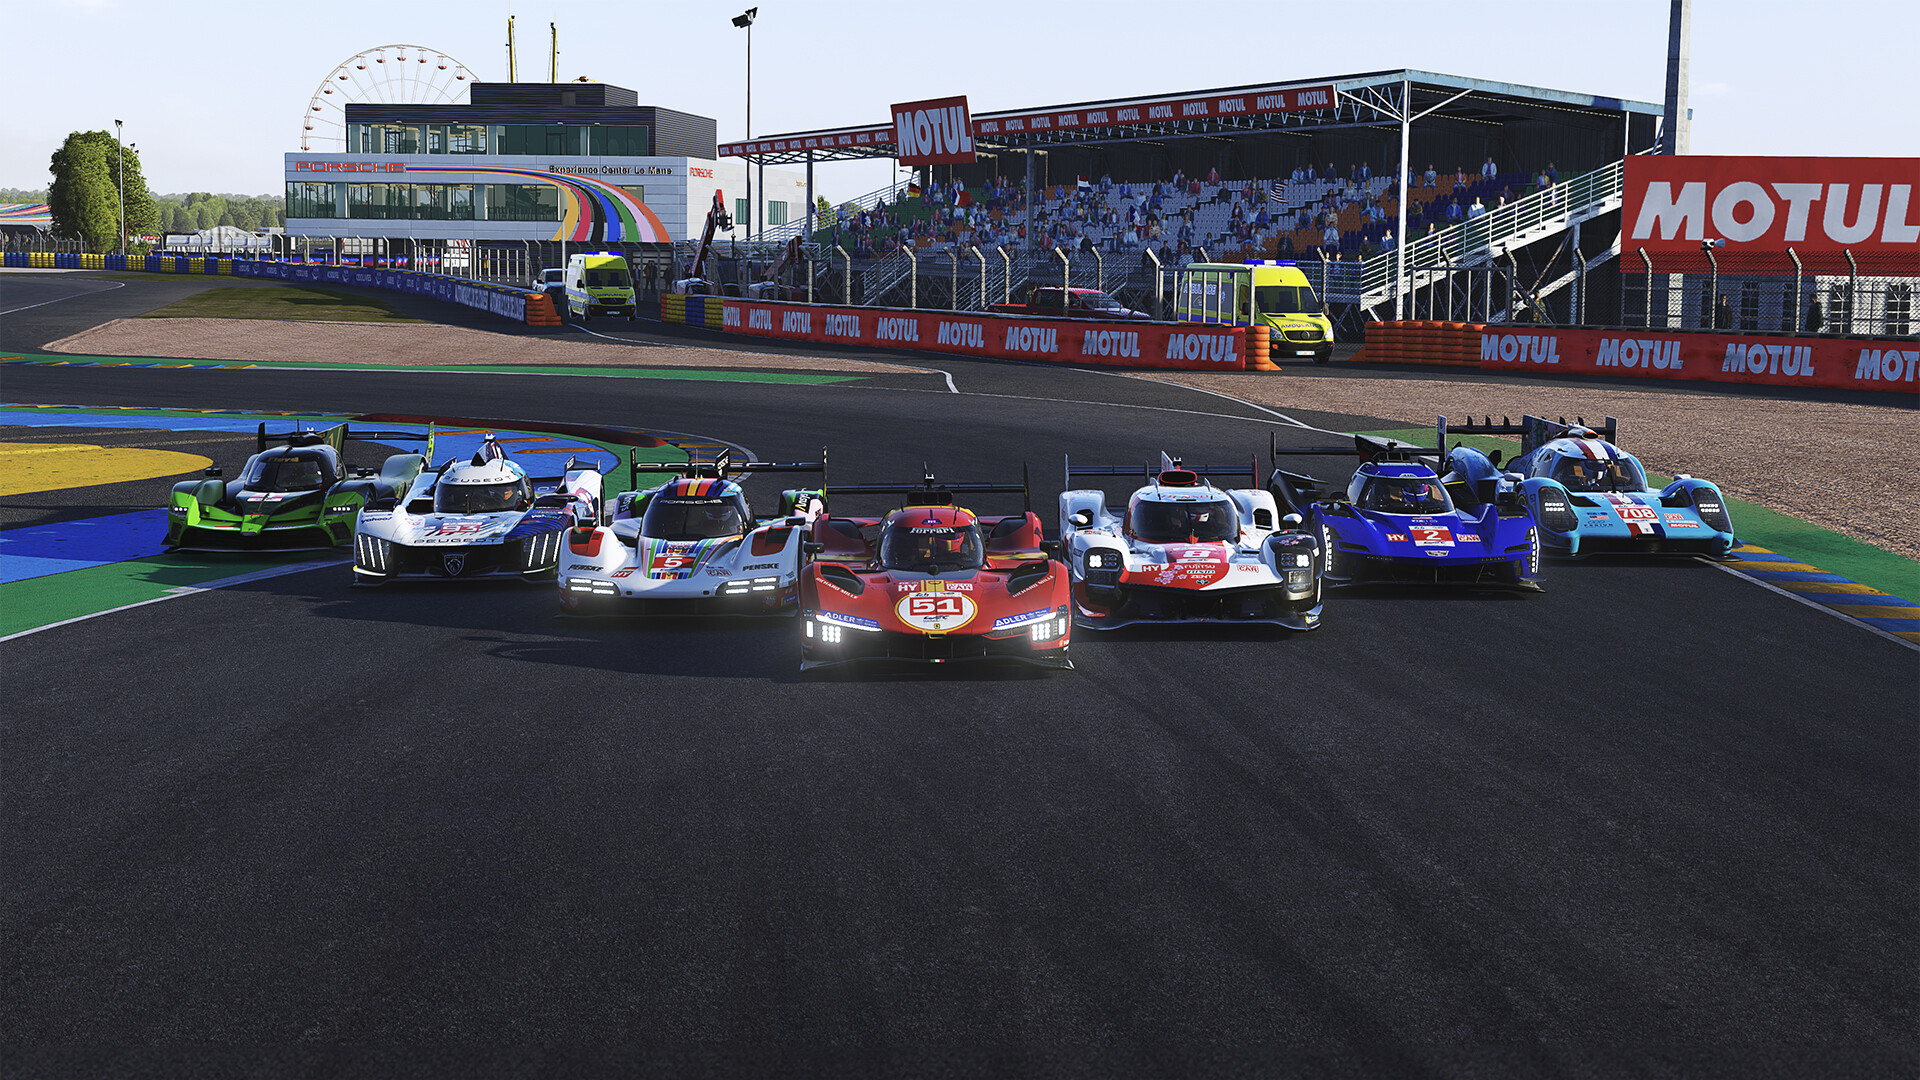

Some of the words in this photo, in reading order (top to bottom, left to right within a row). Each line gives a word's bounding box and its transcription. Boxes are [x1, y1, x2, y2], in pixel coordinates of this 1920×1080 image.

[981, 122, 999, 133] MOTUL
[1005, 119, 1024, 131] MOTUL
[1031, 117, 1050, 129] MOTUL
[1058, 114, 1079, 126] MOTUL
[1087, 111, 1109, 124] MOTUL
[1117, 108, 1140, 122] MOTUL
[1149, 105, 1173, 119] MOTUL
[1183, 102, 1209, 116] MOTUL
[1218, 98, 1246, 113] MOTUL
[1256, 94, 1286, 110] MOTUL
[1297, 90, 1328, 106] MOTUL
[896, 105, 972, 157] MOTUL
[296, 162, 405, 172] PORSCHE
[549, 165, 599, 175] Experience
[602, 165, 631, 174] Center
[635, 166, 646, 174] Le
[649, 166, 673, 175] Mans
[690, 167, 713, 179] PORSCHE
[1631, 181, 1920, 244] MOTUL
[749, 308, 772, 330] MOTUL
[782, 311, 812, 334] MOTUL
[825, 314, 861, 338] MOTUL
[876, 317, 919, 342] MOTUL
[937, 321, 985, 348] MOTUL
[1005, 326, 1059, 353] MOTUL
[1082, 330, 1141, 358] MOTUL
[1166, 333, 1238, 362] MOTUL
[1480, 334, 1560, 364] MOTUL
[1596, 338, 1684, 370] MOTUL
[1722, 343, 1815, 376] MOTUL
[1854, 349, 1920, 382] MOT
[1617, 508, 1656, 518] 708
[441, 525, 478, 533] 93
[1423, 530, 1442, 541] 2
[663, 558, 683, 568] 5
[743, 563, 779, 571] PENSKE
[913, 599, 960, 612] 51
[824, 612, 856, 622] ADLER
[995, 614, 1028, 626] ADLER
